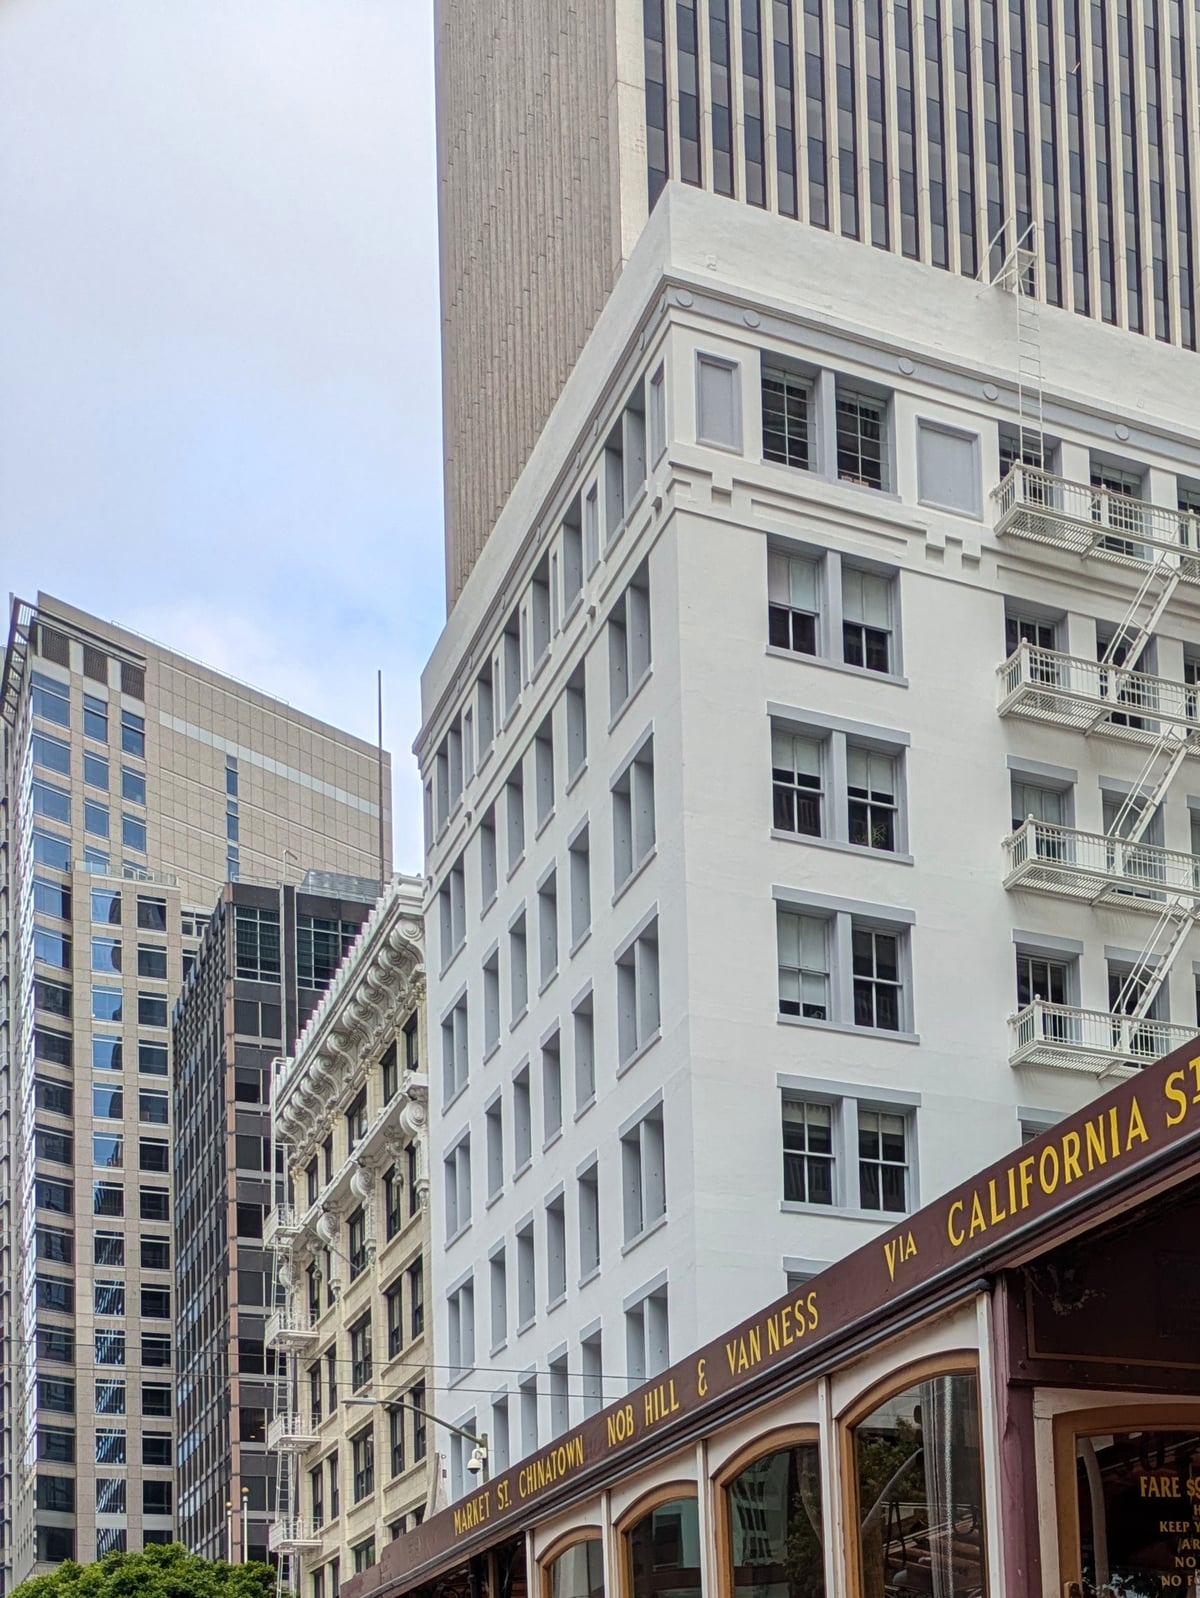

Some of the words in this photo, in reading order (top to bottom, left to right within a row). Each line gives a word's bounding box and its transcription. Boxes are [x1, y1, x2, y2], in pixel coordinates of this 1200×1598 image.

[454, 1491, 491, 1536] MARKET
[519, 1434, 585, 1498] CHINATOWN
[606, 1404, 634, 1448] NOB
[644, 1379, 680, 1426] HILL
[697, 1358, 709, 1397] &
[726, 1325, 762, 1377] VAN
[768, 1291, 819, 1355] NESS
[883, 1231, 918, 1282] VIA
[947, 1095, 1149, 1248] CALIFORNIA
[1140, 1476, 1181, 1498] FARE
[1159, 1521, 1190, 1533] KEEP
[1175, 1556, 1197, 1568] NO
[1161, 1575, 1182, 1587] NO
